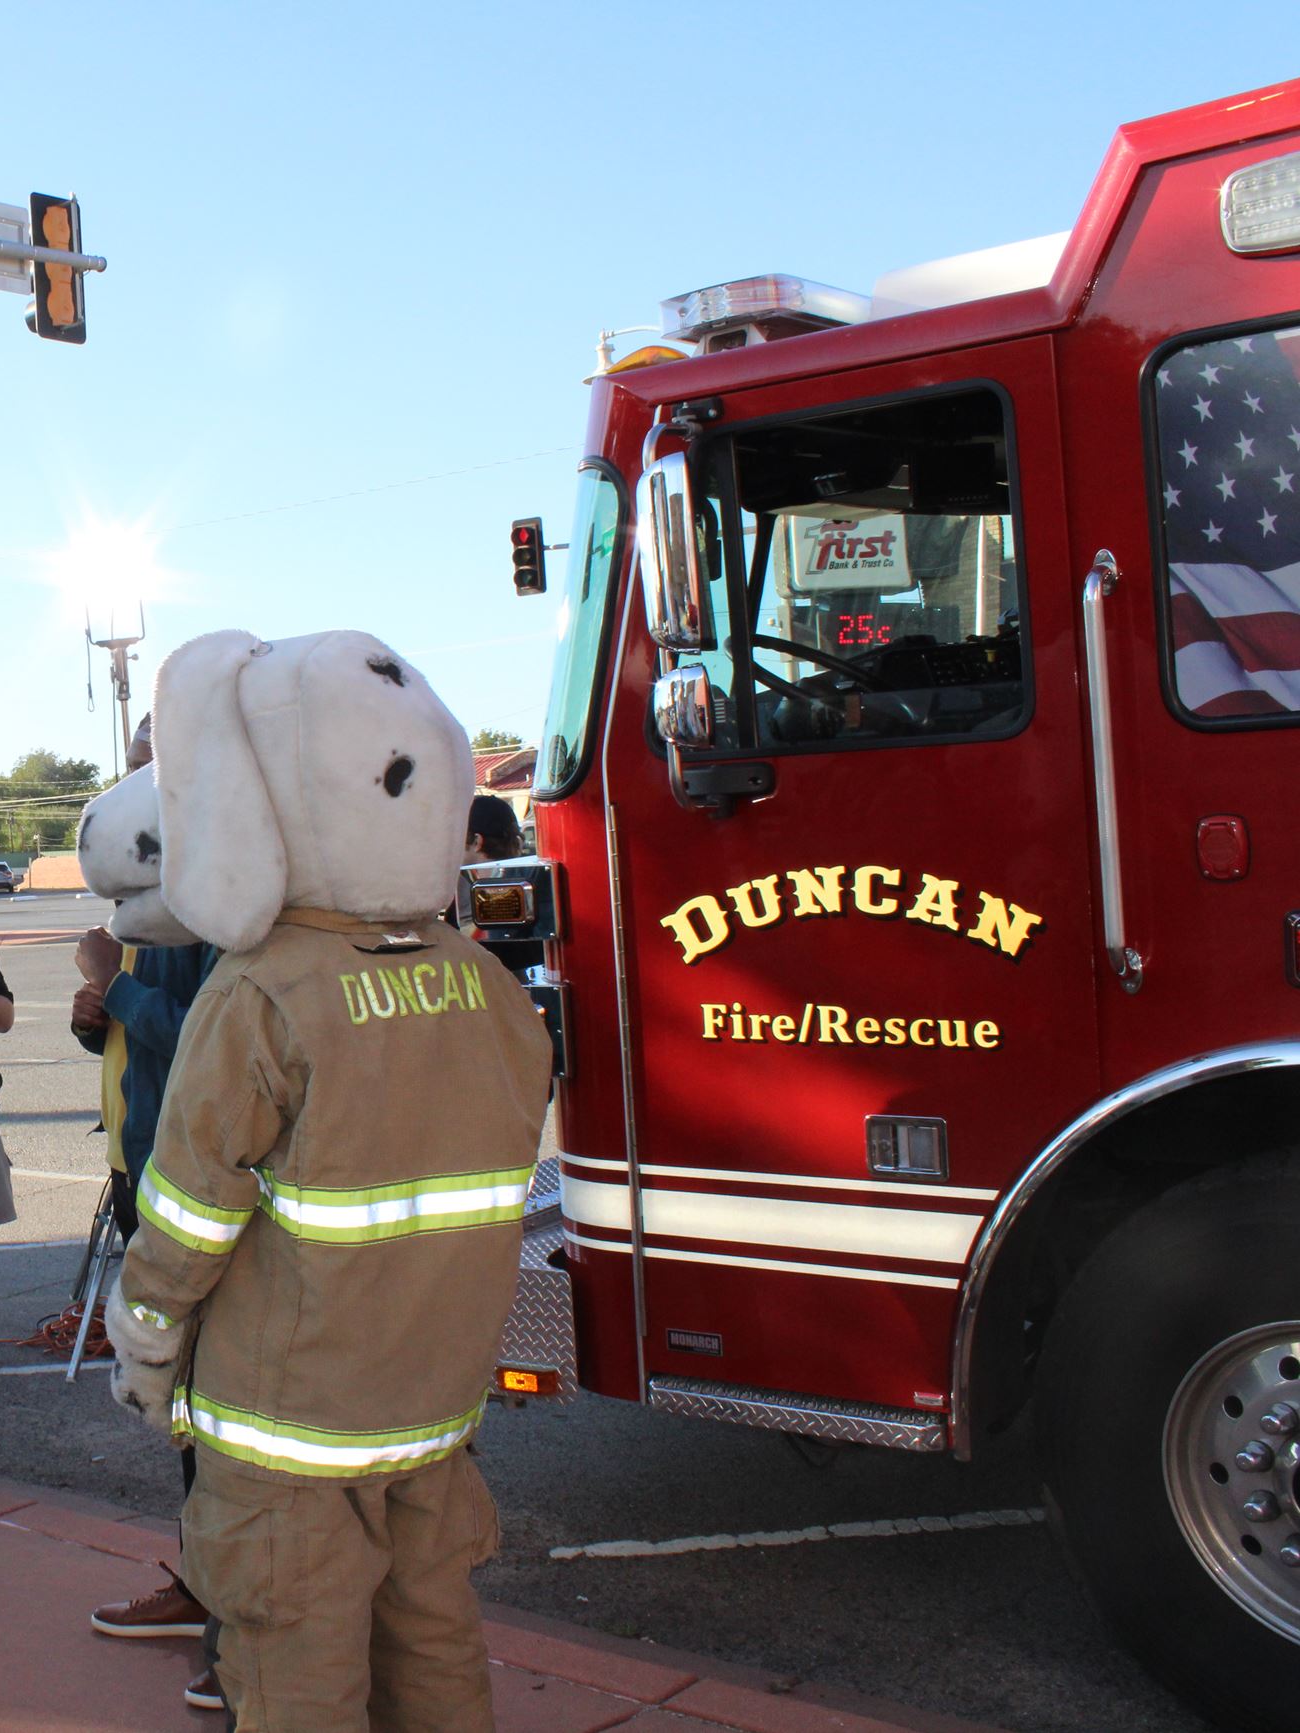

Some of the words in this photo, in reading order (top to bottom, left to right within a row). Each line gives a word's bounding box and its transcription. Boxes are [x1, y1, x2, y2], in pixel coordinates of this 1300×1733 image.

[828, 560, 849, 570] Bank
[851, 560, 859, 569] &
[861, 559, 881, 569] Trust
[660, 865, 1044, 966] DUNCAN
[338, 960, 488, 1025] DUNCAN
[701, 1002, 1002, 1049] Fire/Rescue
[670, 1332, 719, 1350] MONARCH
